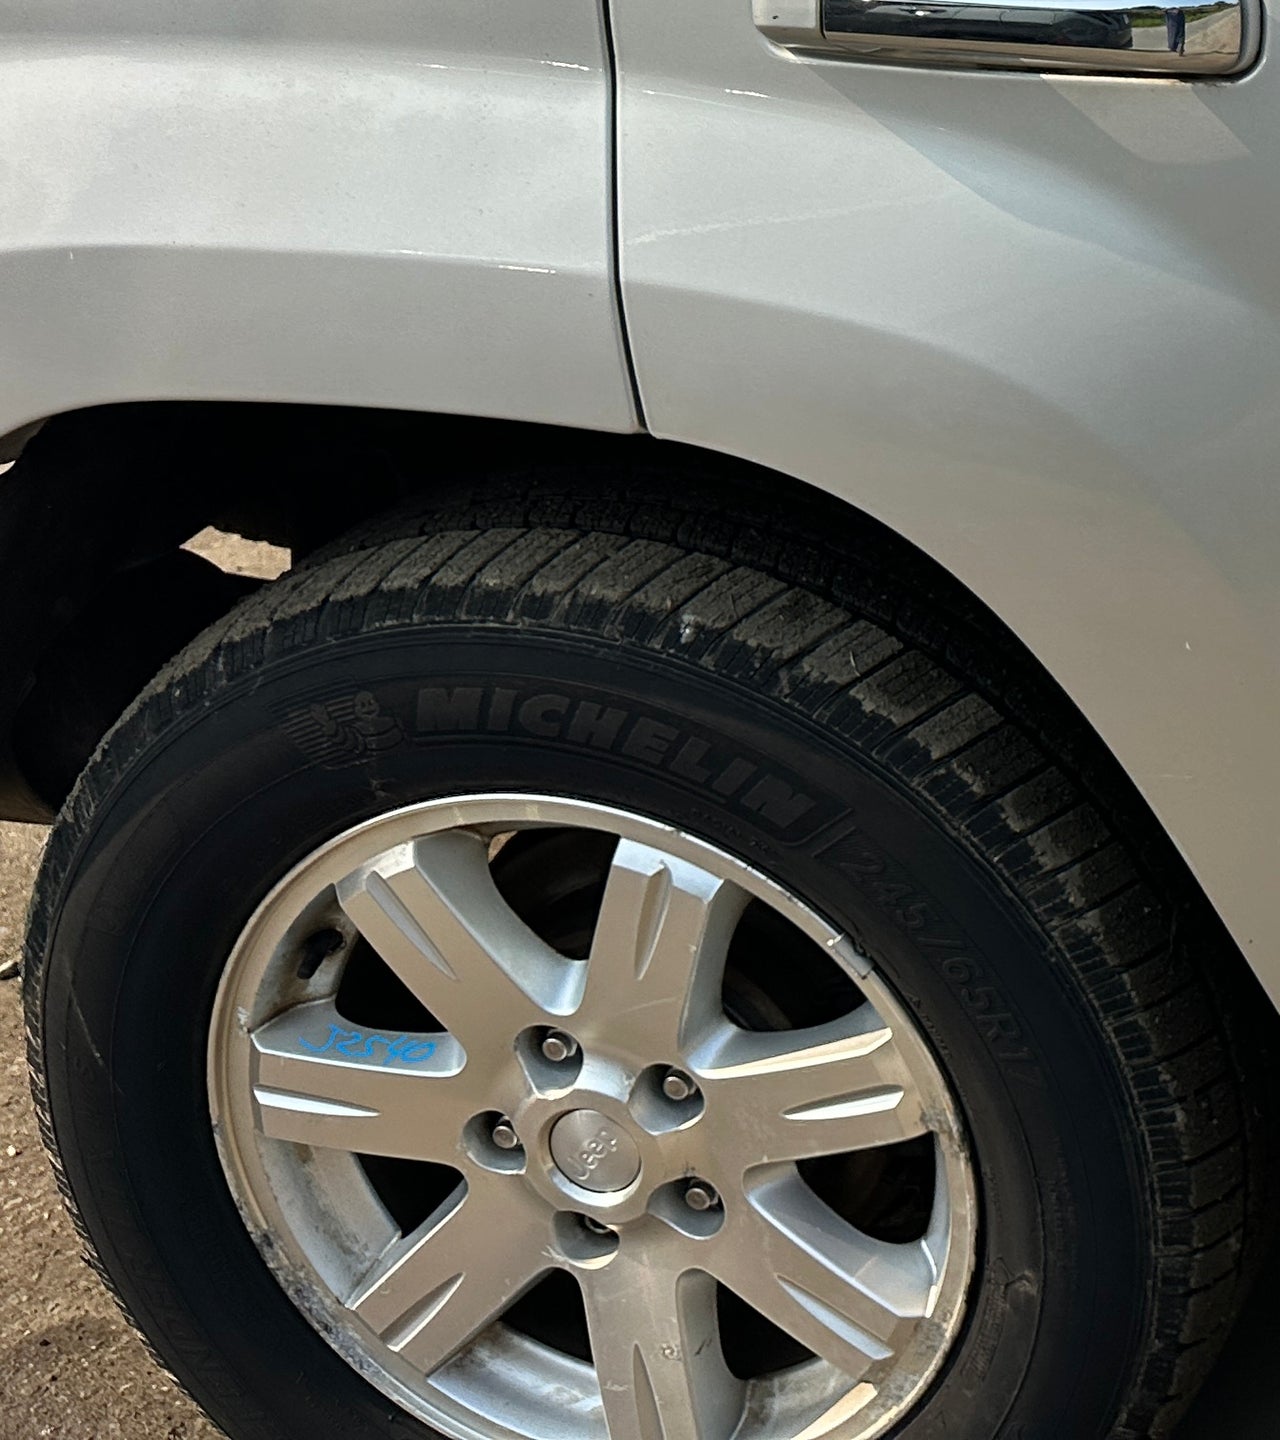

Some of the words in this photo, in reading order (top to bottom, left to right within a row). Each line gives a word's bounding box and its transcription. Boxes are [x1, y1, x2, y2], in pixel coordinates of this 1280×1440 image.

[415, 685, 818, 829] MICHELIN
[299, 1023, 438, 1066] J2540
[566, 1127, 618, 1181] Jeep
